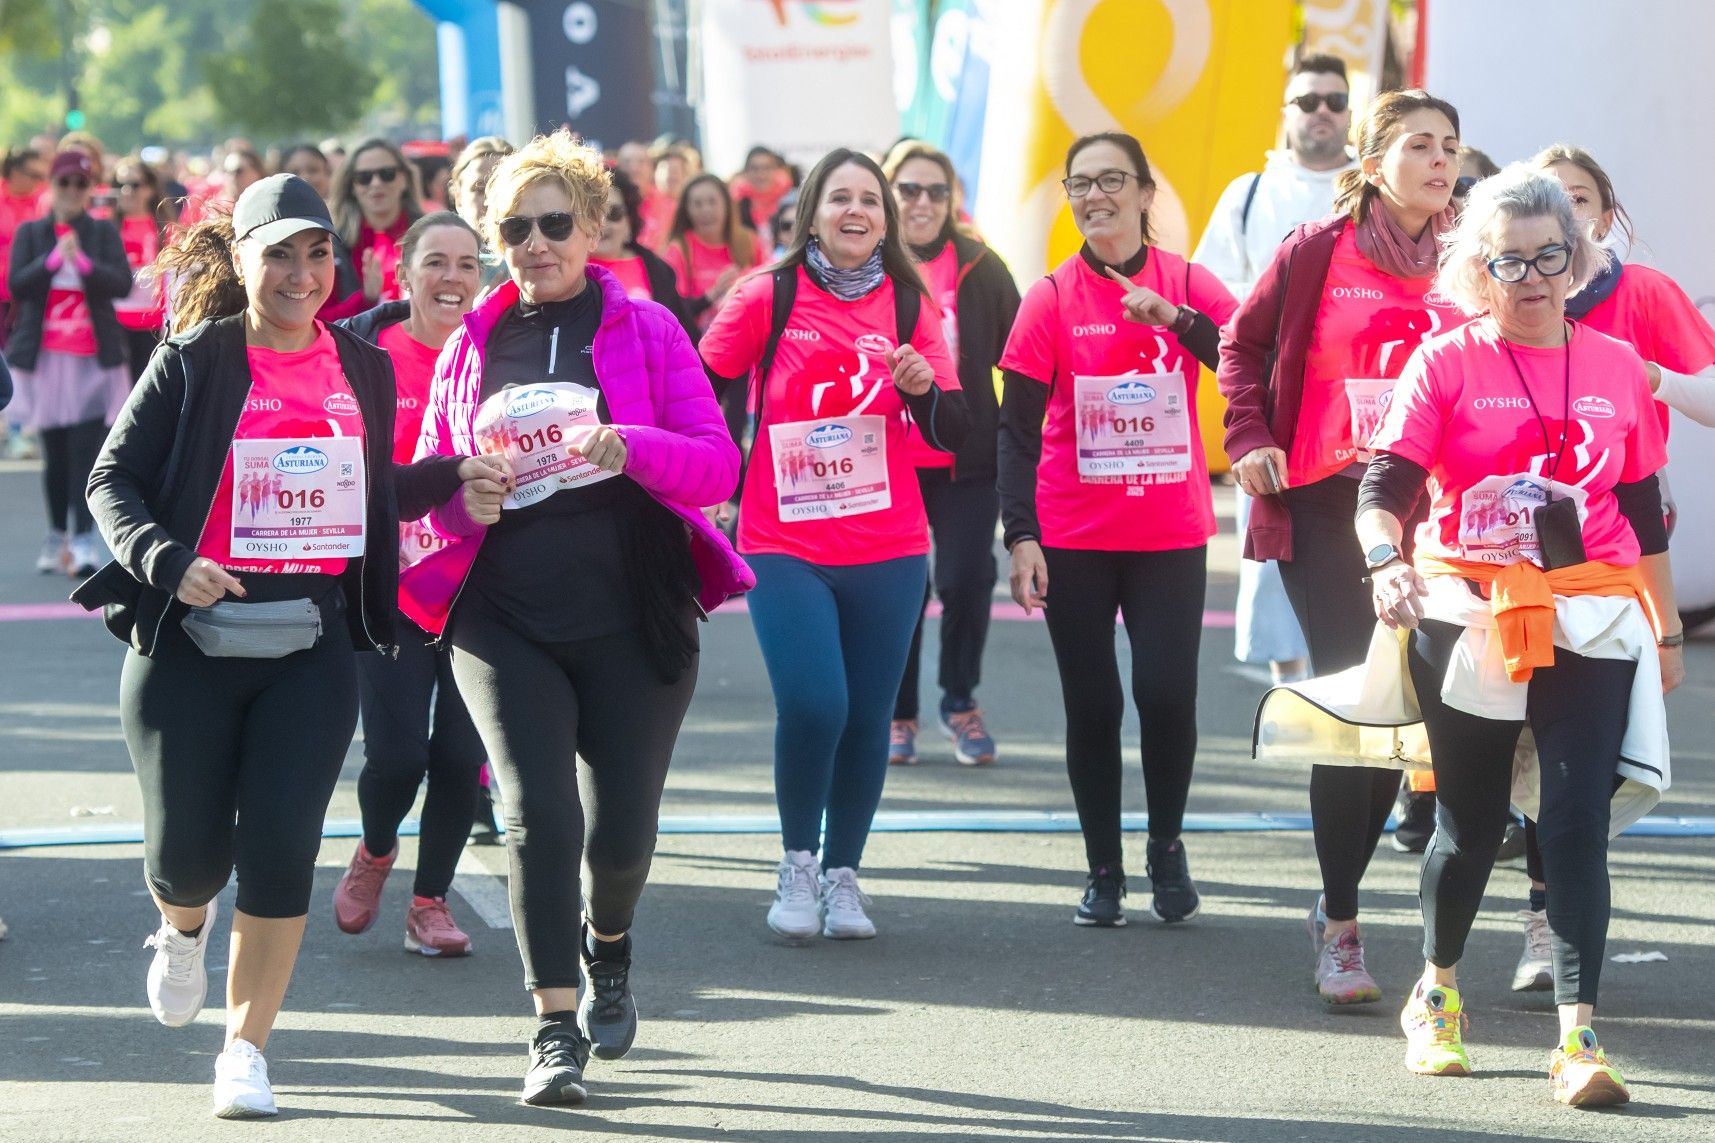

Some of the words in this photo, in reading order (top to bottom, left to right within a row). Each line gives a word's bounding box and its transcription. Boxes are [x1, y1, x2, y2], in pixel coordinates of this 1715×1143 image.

[1332, 287, 1383, 300] OYSHO
[782, 328, 820, 342] YSHO
[1072, 323, 1116, 337] OYSHO
[1111, 391, 1153, 401] ASTURIANA
[244, 398, 282, 412] YSHO
[1473, 397, 1530, 410] OYSHO
[1113, 416, 1155, 433] 016
[518, 424, 563, 453] 016
[809, 432, 849, 444] ASTURIANA
[1124, 439, 1145, 447] 4409
[244, 461, 270, 469] SUMA
[277, 456, 325, 468] ASTURIANA
[536, 453, 558, 467] 1978
[1089, 461, 1124, 470] OYSHO
[813, 457, 854, 478] 016
[513, 484, 546, 501] OYSHO
[567, 466, 601, 482] Santande
[825, 482, 846, 491] 4406
[278, 488, 325, 509] 016
[792, 504, 827, 515] OYSHO
[290, 516, 312, 526] 1977
[1505, 507, 1531, 526] 01
[280, 529, 289, 537] DE
[299, 528, 318, 536] MUJER
[322, 527, 345, 535] SEVILLA
[246, 543, 288, 552] OYSHO
[312, 543, 350, 551] Santander
[419, 533, 448, 549] 01
